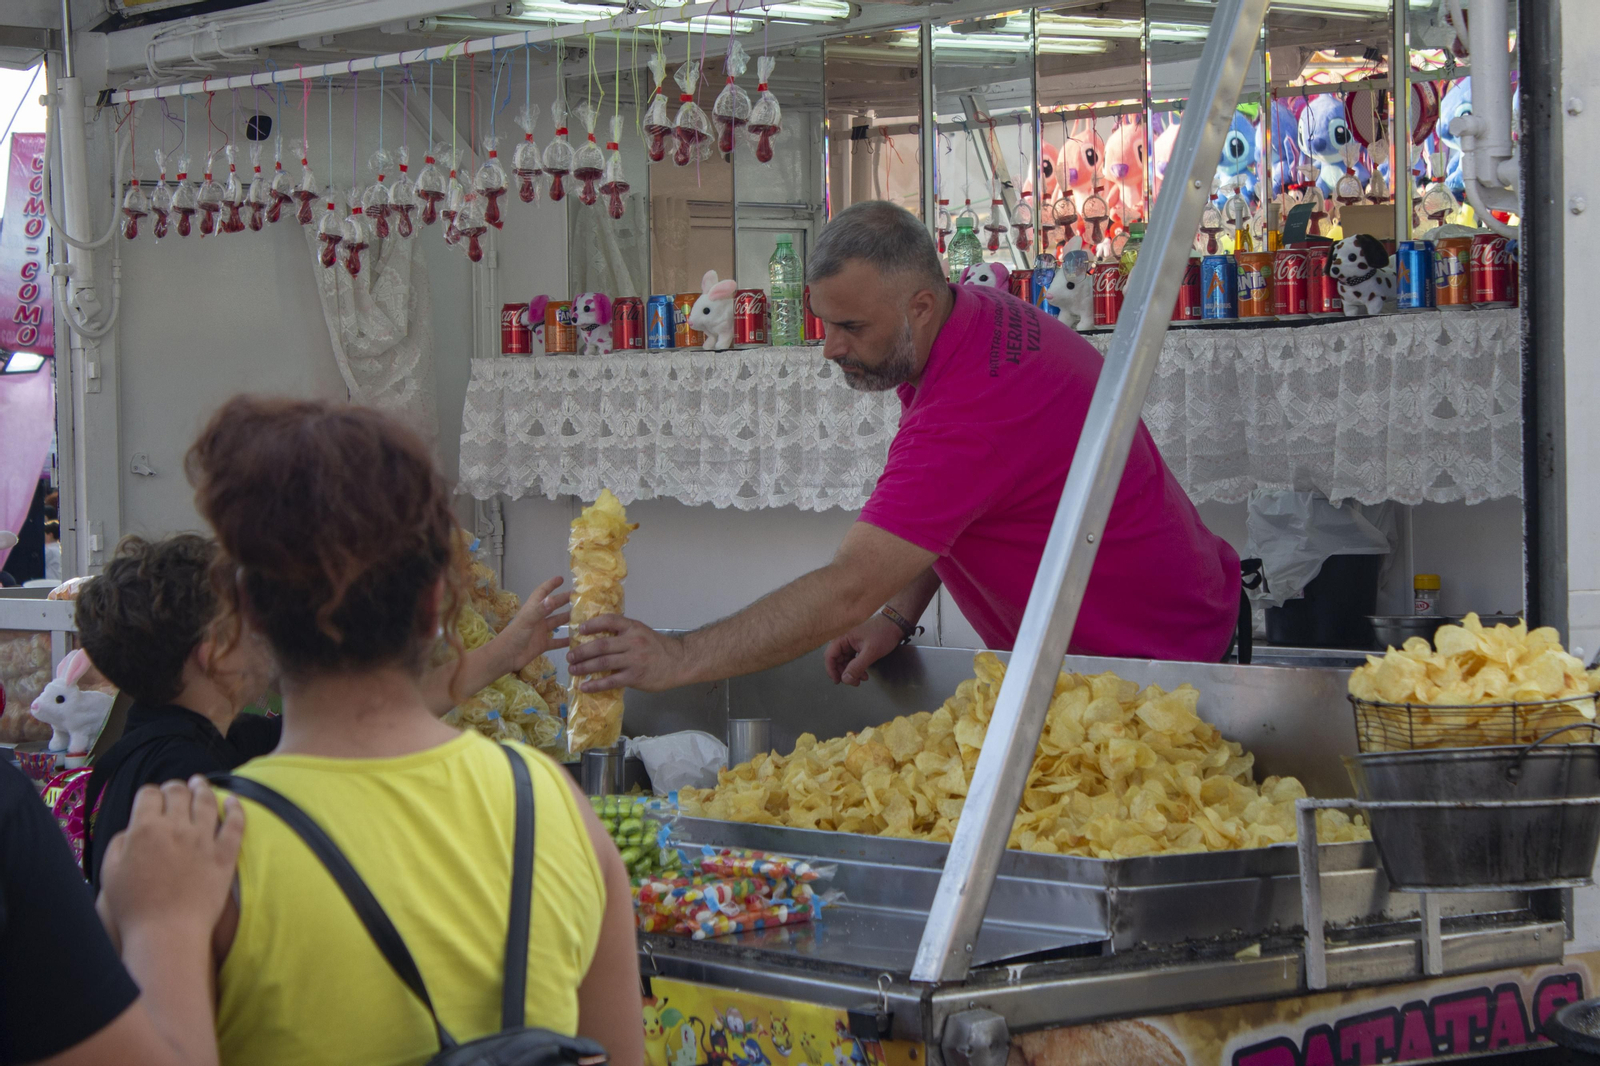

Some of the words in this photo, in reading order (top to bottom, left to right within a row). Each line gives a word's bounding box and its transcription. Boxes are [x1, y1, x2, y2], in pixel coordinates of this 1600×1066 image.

[1435, 257, 1465, 278] ANTA
[1238, 271, 1267, 291] ANTA
[555, 309, 573, 323] FAN
[988, 329, 1002, 378] PATATAS
[1233, 974, 1583, 1066] ATATAS
